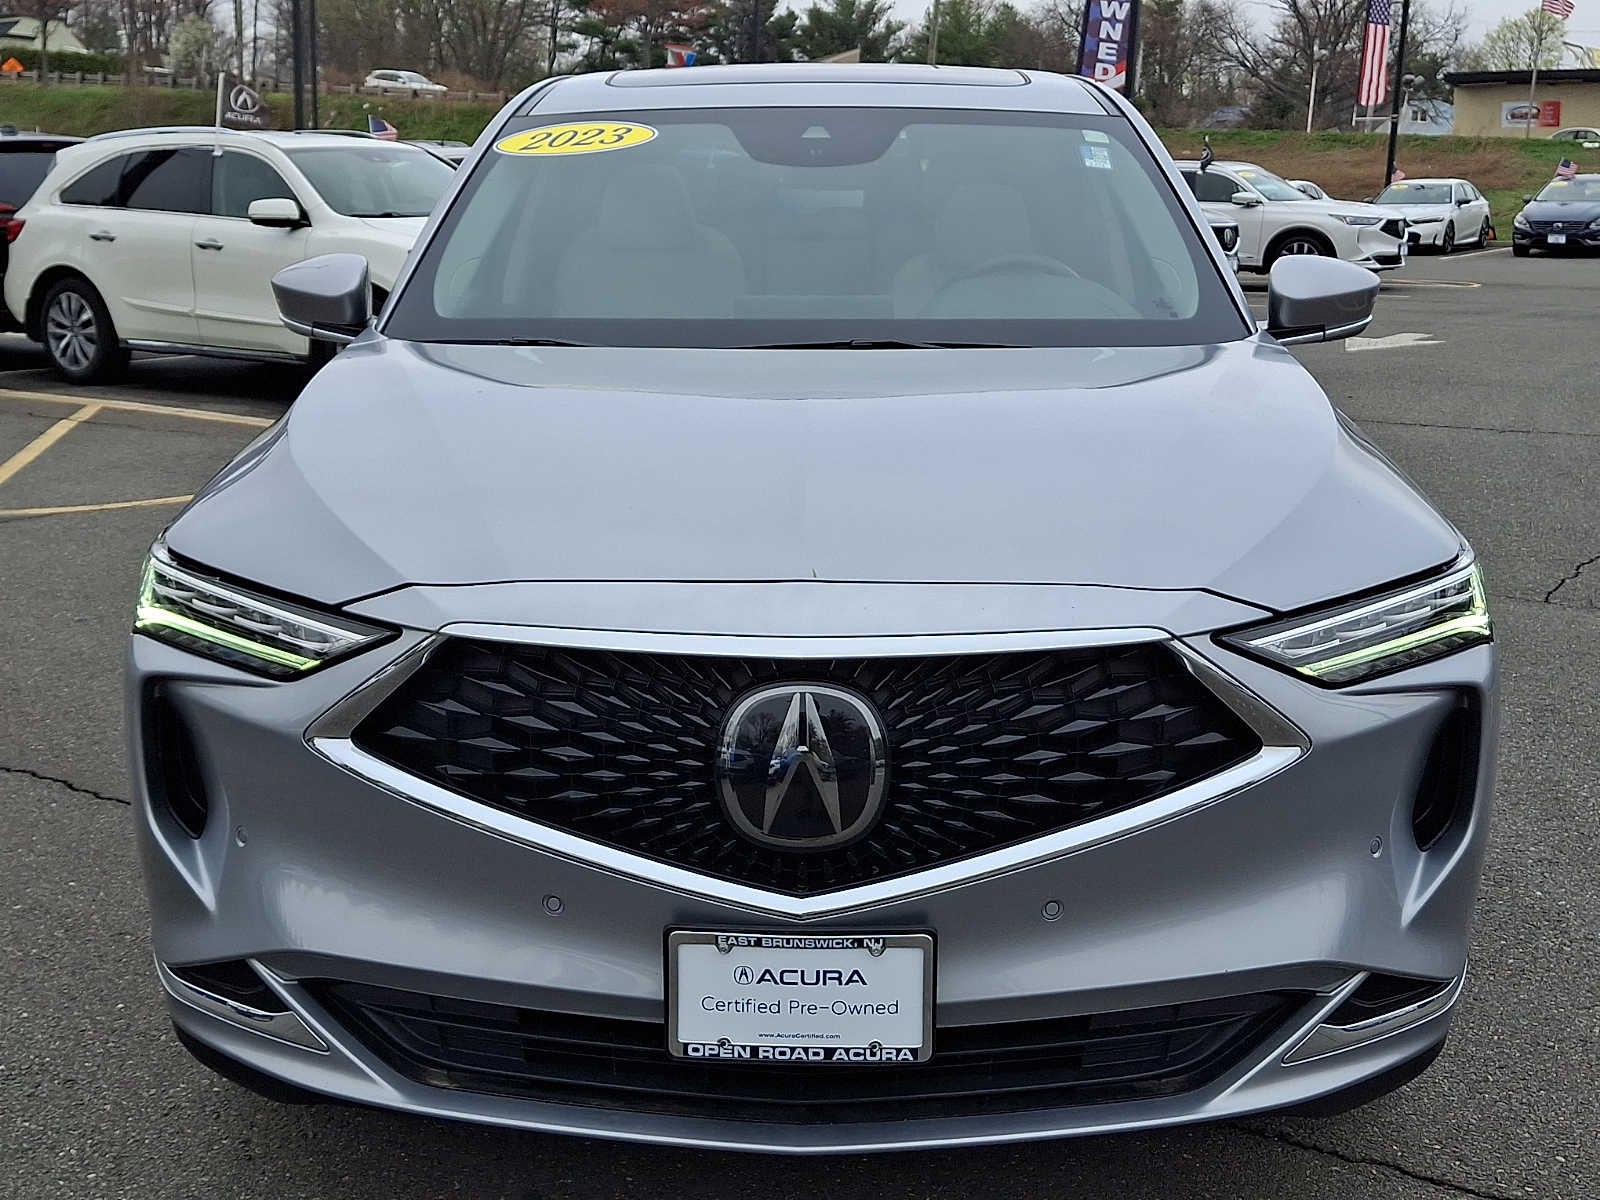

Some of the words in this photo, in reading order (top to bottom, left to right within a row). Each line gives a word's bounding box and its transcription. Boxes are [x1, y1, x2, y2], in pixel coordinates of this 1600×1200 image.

[224, 111, 262, 125] ACURA
[518, 126, 633, 152] 2023
[717, 935, 758, 947] EAST
[761, 936, 859, 949] BRUNSWICK,
[863, 937, 884, 948] NJ
[755, 968, 868, 986] ACURA
[701, 995, 781, 1014] Certified
[789, 999, 899, 1016] Pre-Owned
[758, 1031, 841, 1040] www.AcuraCertified.com
[687, 1043, 751, 1059] OPEN
[758, 1046, 825, 1061] ROAD
[832, 1047, 914, 1062] ACURA
